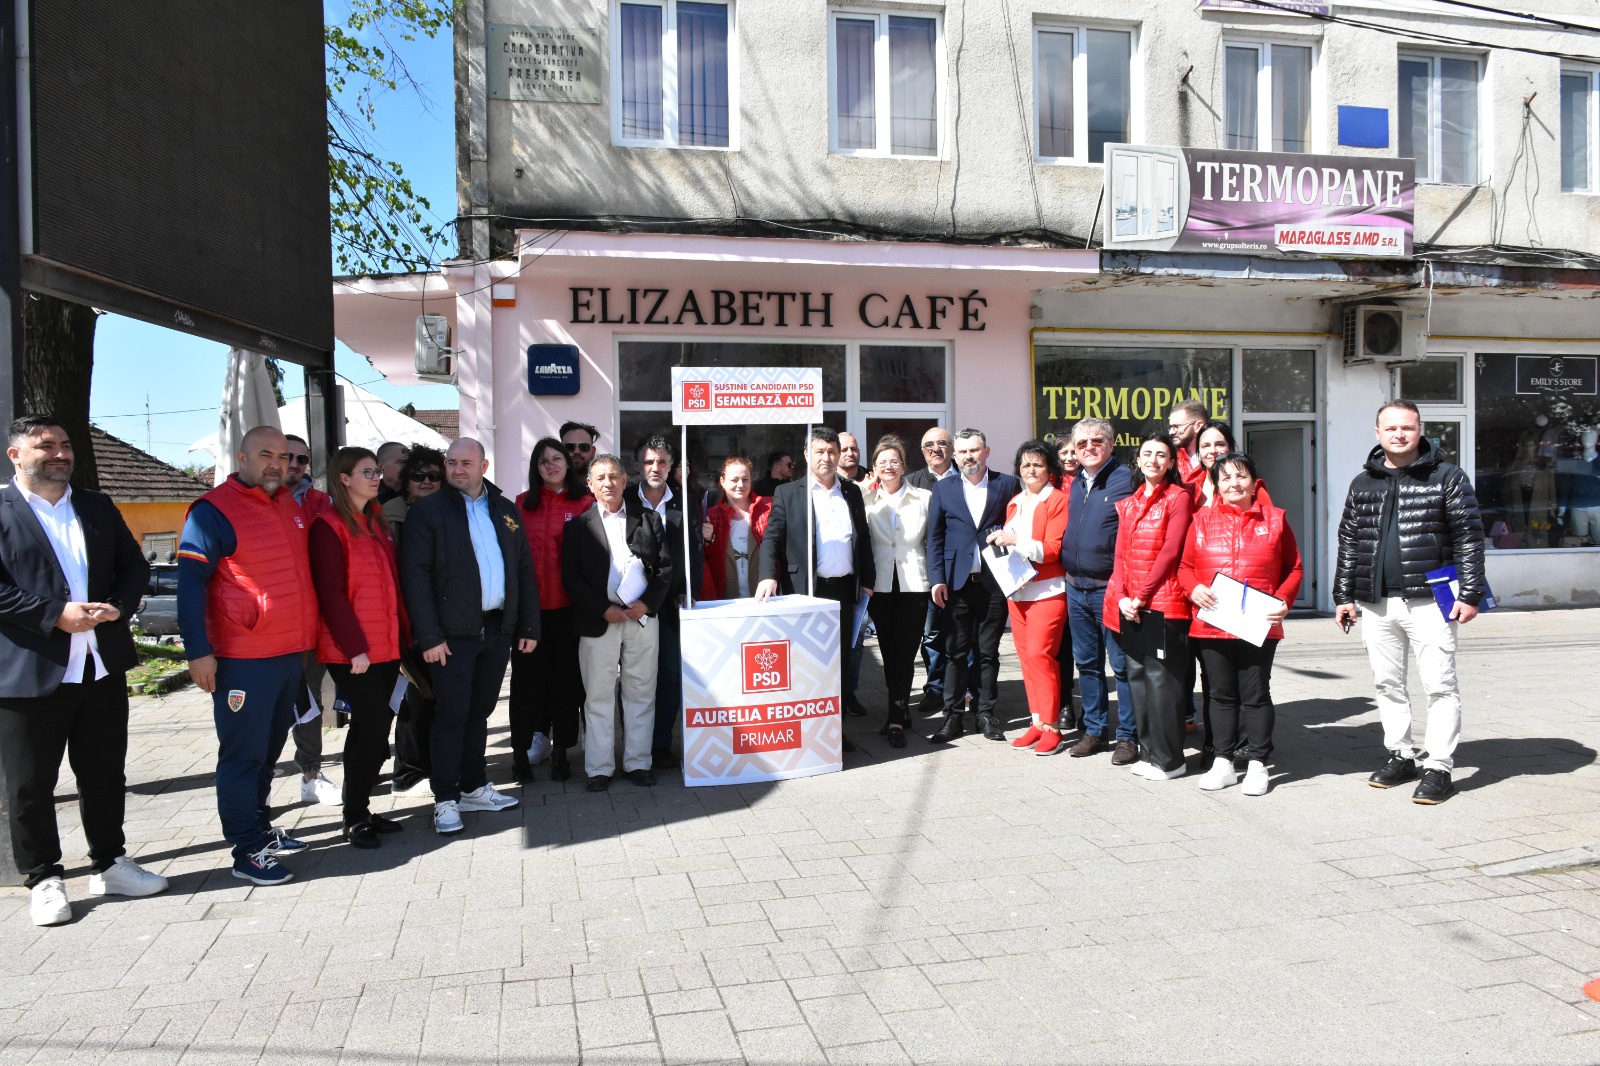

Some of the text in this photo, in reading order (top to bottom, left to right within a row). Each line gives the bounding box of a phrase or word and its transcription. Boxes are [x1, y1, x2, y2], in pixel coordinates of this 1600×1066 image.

[503, 42, 584, 57] COOPERATIVA
[508, 68, 581, 82] PRESTAREA
[1196, 161, 1404, 209] TERMOPANE
[1279, 230, 1352, 245] MARAGLASS
[1353, 231, 1380, 246] AMD
[1201, 242, 1268, 251] www.grupsolteris.ro
[568, 287, 988, 331] ELIZABETH CAFÉ
[534, 363, 573, 374] LAVAZZA
[798, 383, 814, 391] PSD
[1530, 377, 1583, 386] EMILY'S STORE
[688, 399, 706, 408] PSD
[785, 395, 813, 405] AICI!
[752, 671, 781, 687] PSD
[691, 700, 835, 725] AURELIA FEDORCA
[740, 728, 795, 747] PRIMAR
